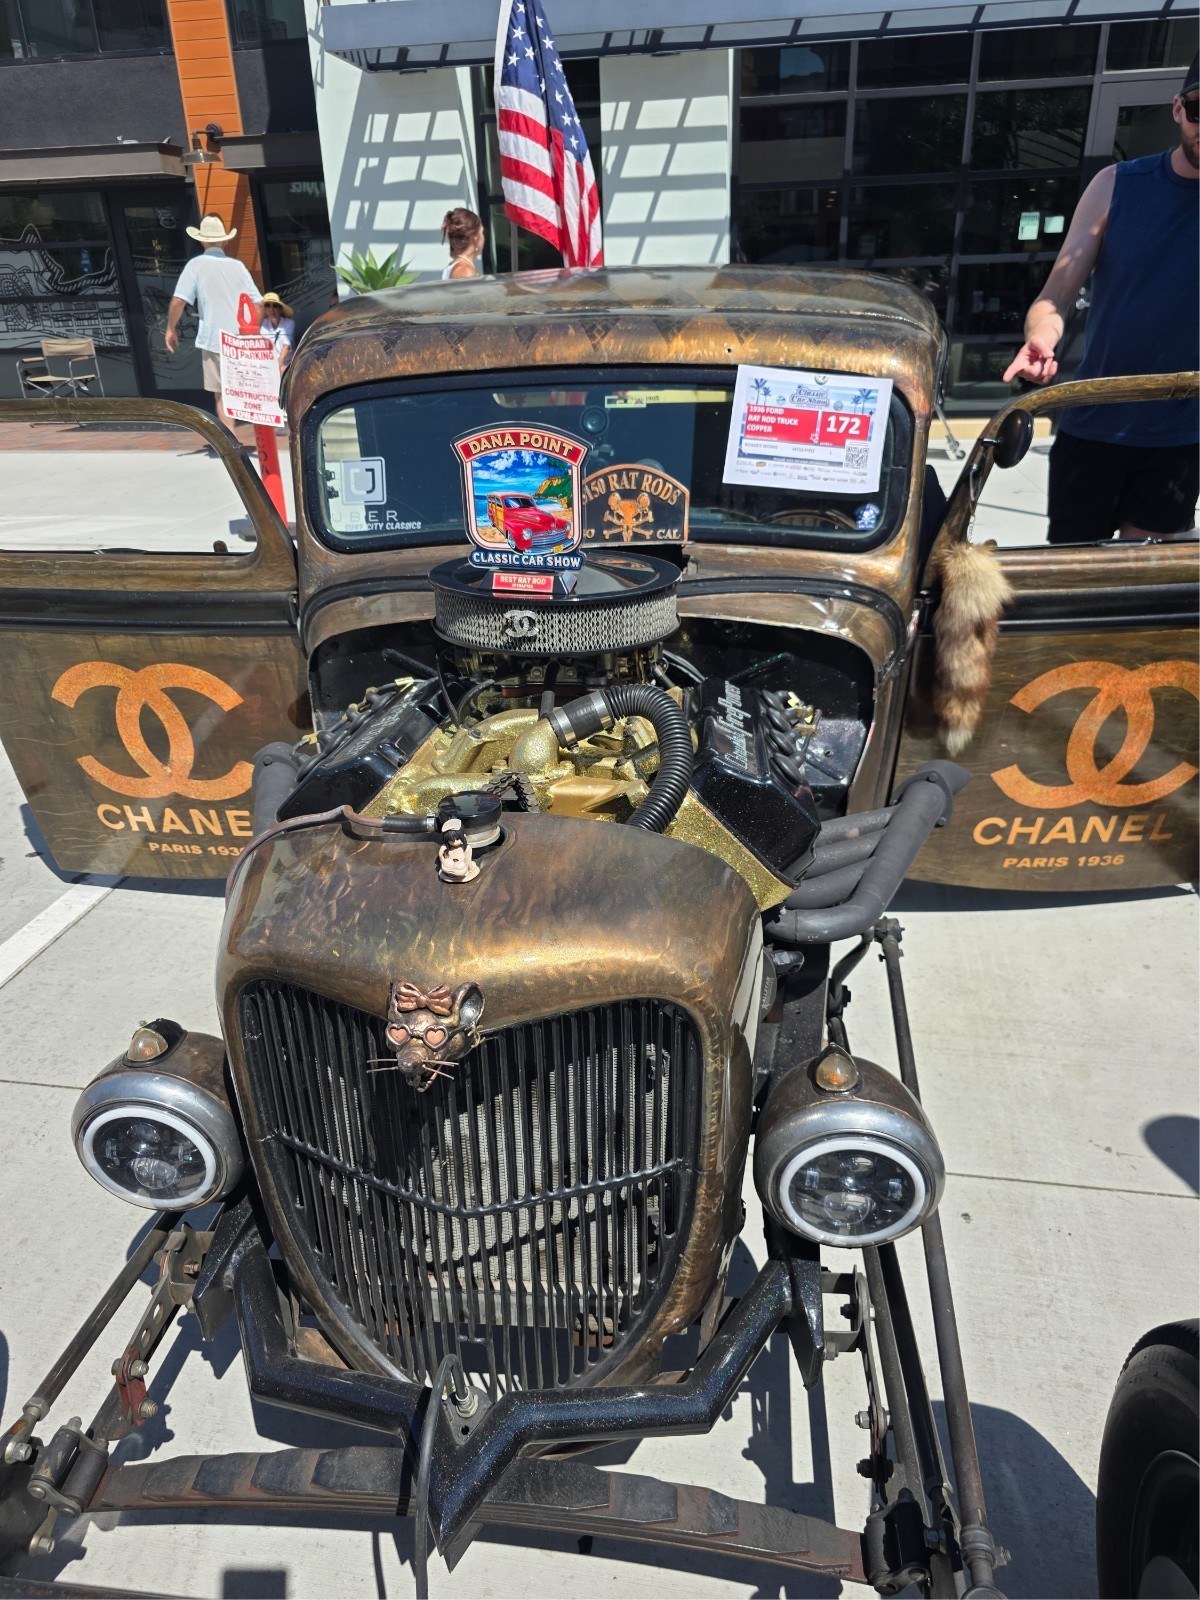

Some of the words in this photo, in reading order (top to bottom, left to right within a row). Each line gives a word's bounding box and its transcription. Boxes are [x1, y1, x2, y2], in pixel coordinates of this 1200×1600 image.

[223, 335, 270, 349] TEMPORARY
[223, 344, 237, 359] NO
[240, 351, 274, 360] PARKING
[225, 388, 280, 402] CONSTRUCTION
[798, 388, 826, 397] Classic
[243, 402, 262, 411] ZONE
[791, 395, 808, 404] Car
[808, 397, 830, 407] Show
[749, 406, 765, 414] 1936
[766, 407, 784, 415] FORD
[761, 416, 776, 424] ROD
[777, 417, 799, 426] TRUCK
[826, 415, 862, 435] 172
[747, 425, 772, 433] COPPER
[468, 433, 515, 455] DANA
[519, 433, 575, 457] POINT
[607, 471, 640, 491] RAT
[640, 473, 682, 506] RODS
[367, 522, 384, 531] CITY
[385, 521, 422, 530] CLASSICS
[583, 528, 596, 539] O
[656, 529, 681, 539] CAL
[472, 552, 519, 565] CLASSIC
[521, 554, 544, 566] CAR
[546, 556, 581, 568] SHOW
[532, 577, 547, 585] ROD
[97, 803, 253, 836] CHANE
[972, 814, 1173, 846] CHANEL
[149, 843, 202, 855] PARIS
[1002, 856, 1069, 869] PARIS
[1077, 855, 1125, 867] 1936
